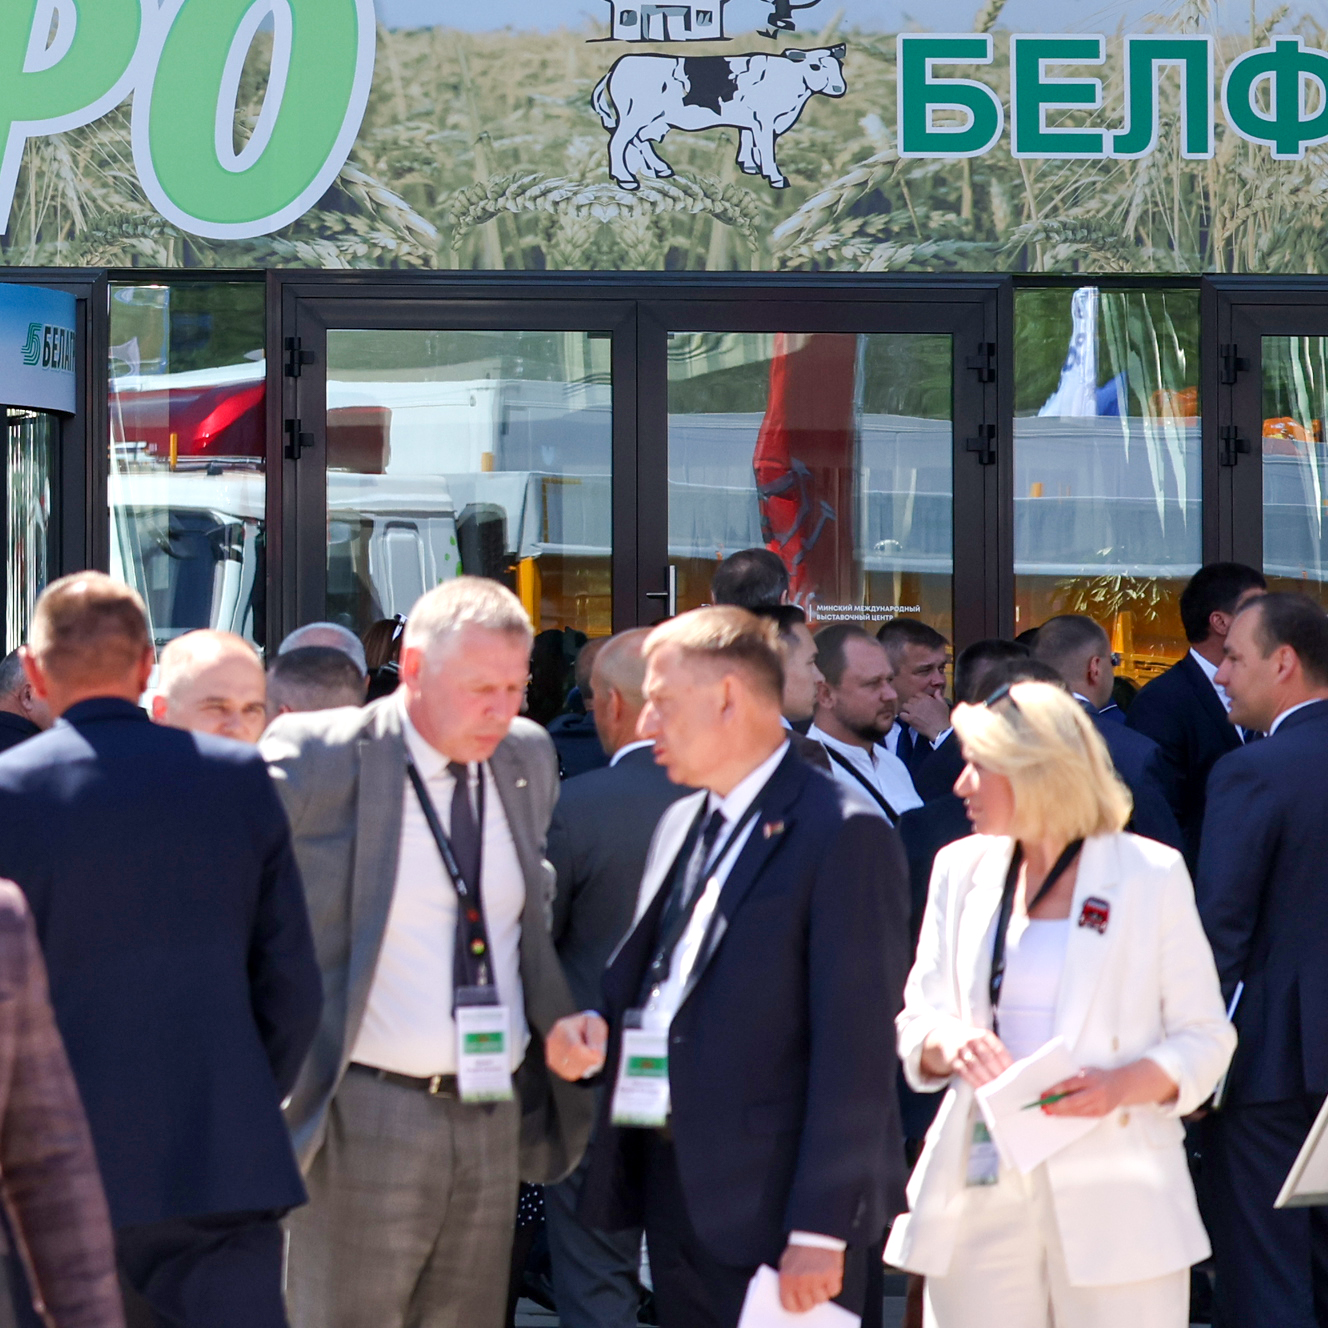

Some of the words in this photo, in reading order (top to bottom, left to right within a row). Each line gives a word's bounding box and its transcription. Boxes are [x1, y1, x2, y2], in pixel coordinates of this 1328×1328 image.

[900, 36, 1328, 156] БЕЛФ
[816, 604, 853, 612] МИНСКИЙ
[854, 604, 921, 613] МЕЖДУНАРОДНЫЙ
[816, 613, 870, 621] ВЫСТАВОЧНЫЙ
[872, 614, 894, 622] ЦЕНТР
